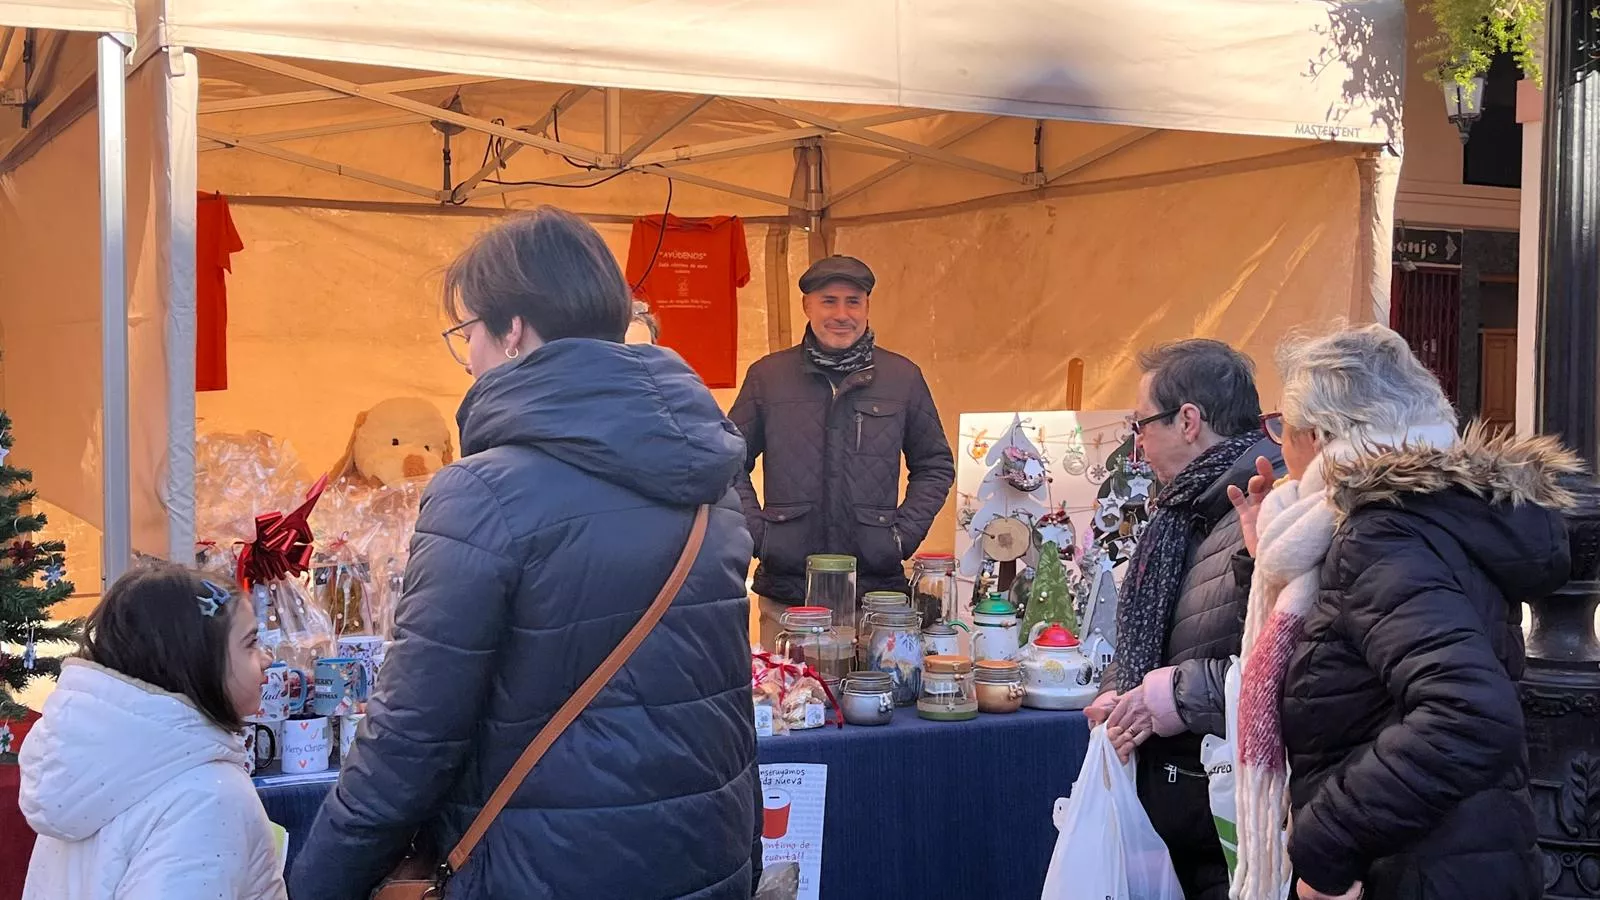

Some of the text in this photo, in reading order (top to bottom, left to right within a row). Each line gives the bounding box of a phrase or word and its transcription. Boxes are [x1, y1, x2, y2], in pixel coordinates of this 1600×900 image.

[1295, 123, 1361, 138] MASTERTENT
[1397, 240, 1438, 259] onje
[760, 769, 806, 778] nstruyamos
[762, 777, 772, 785] da
[800, 841, 810, 849] de
